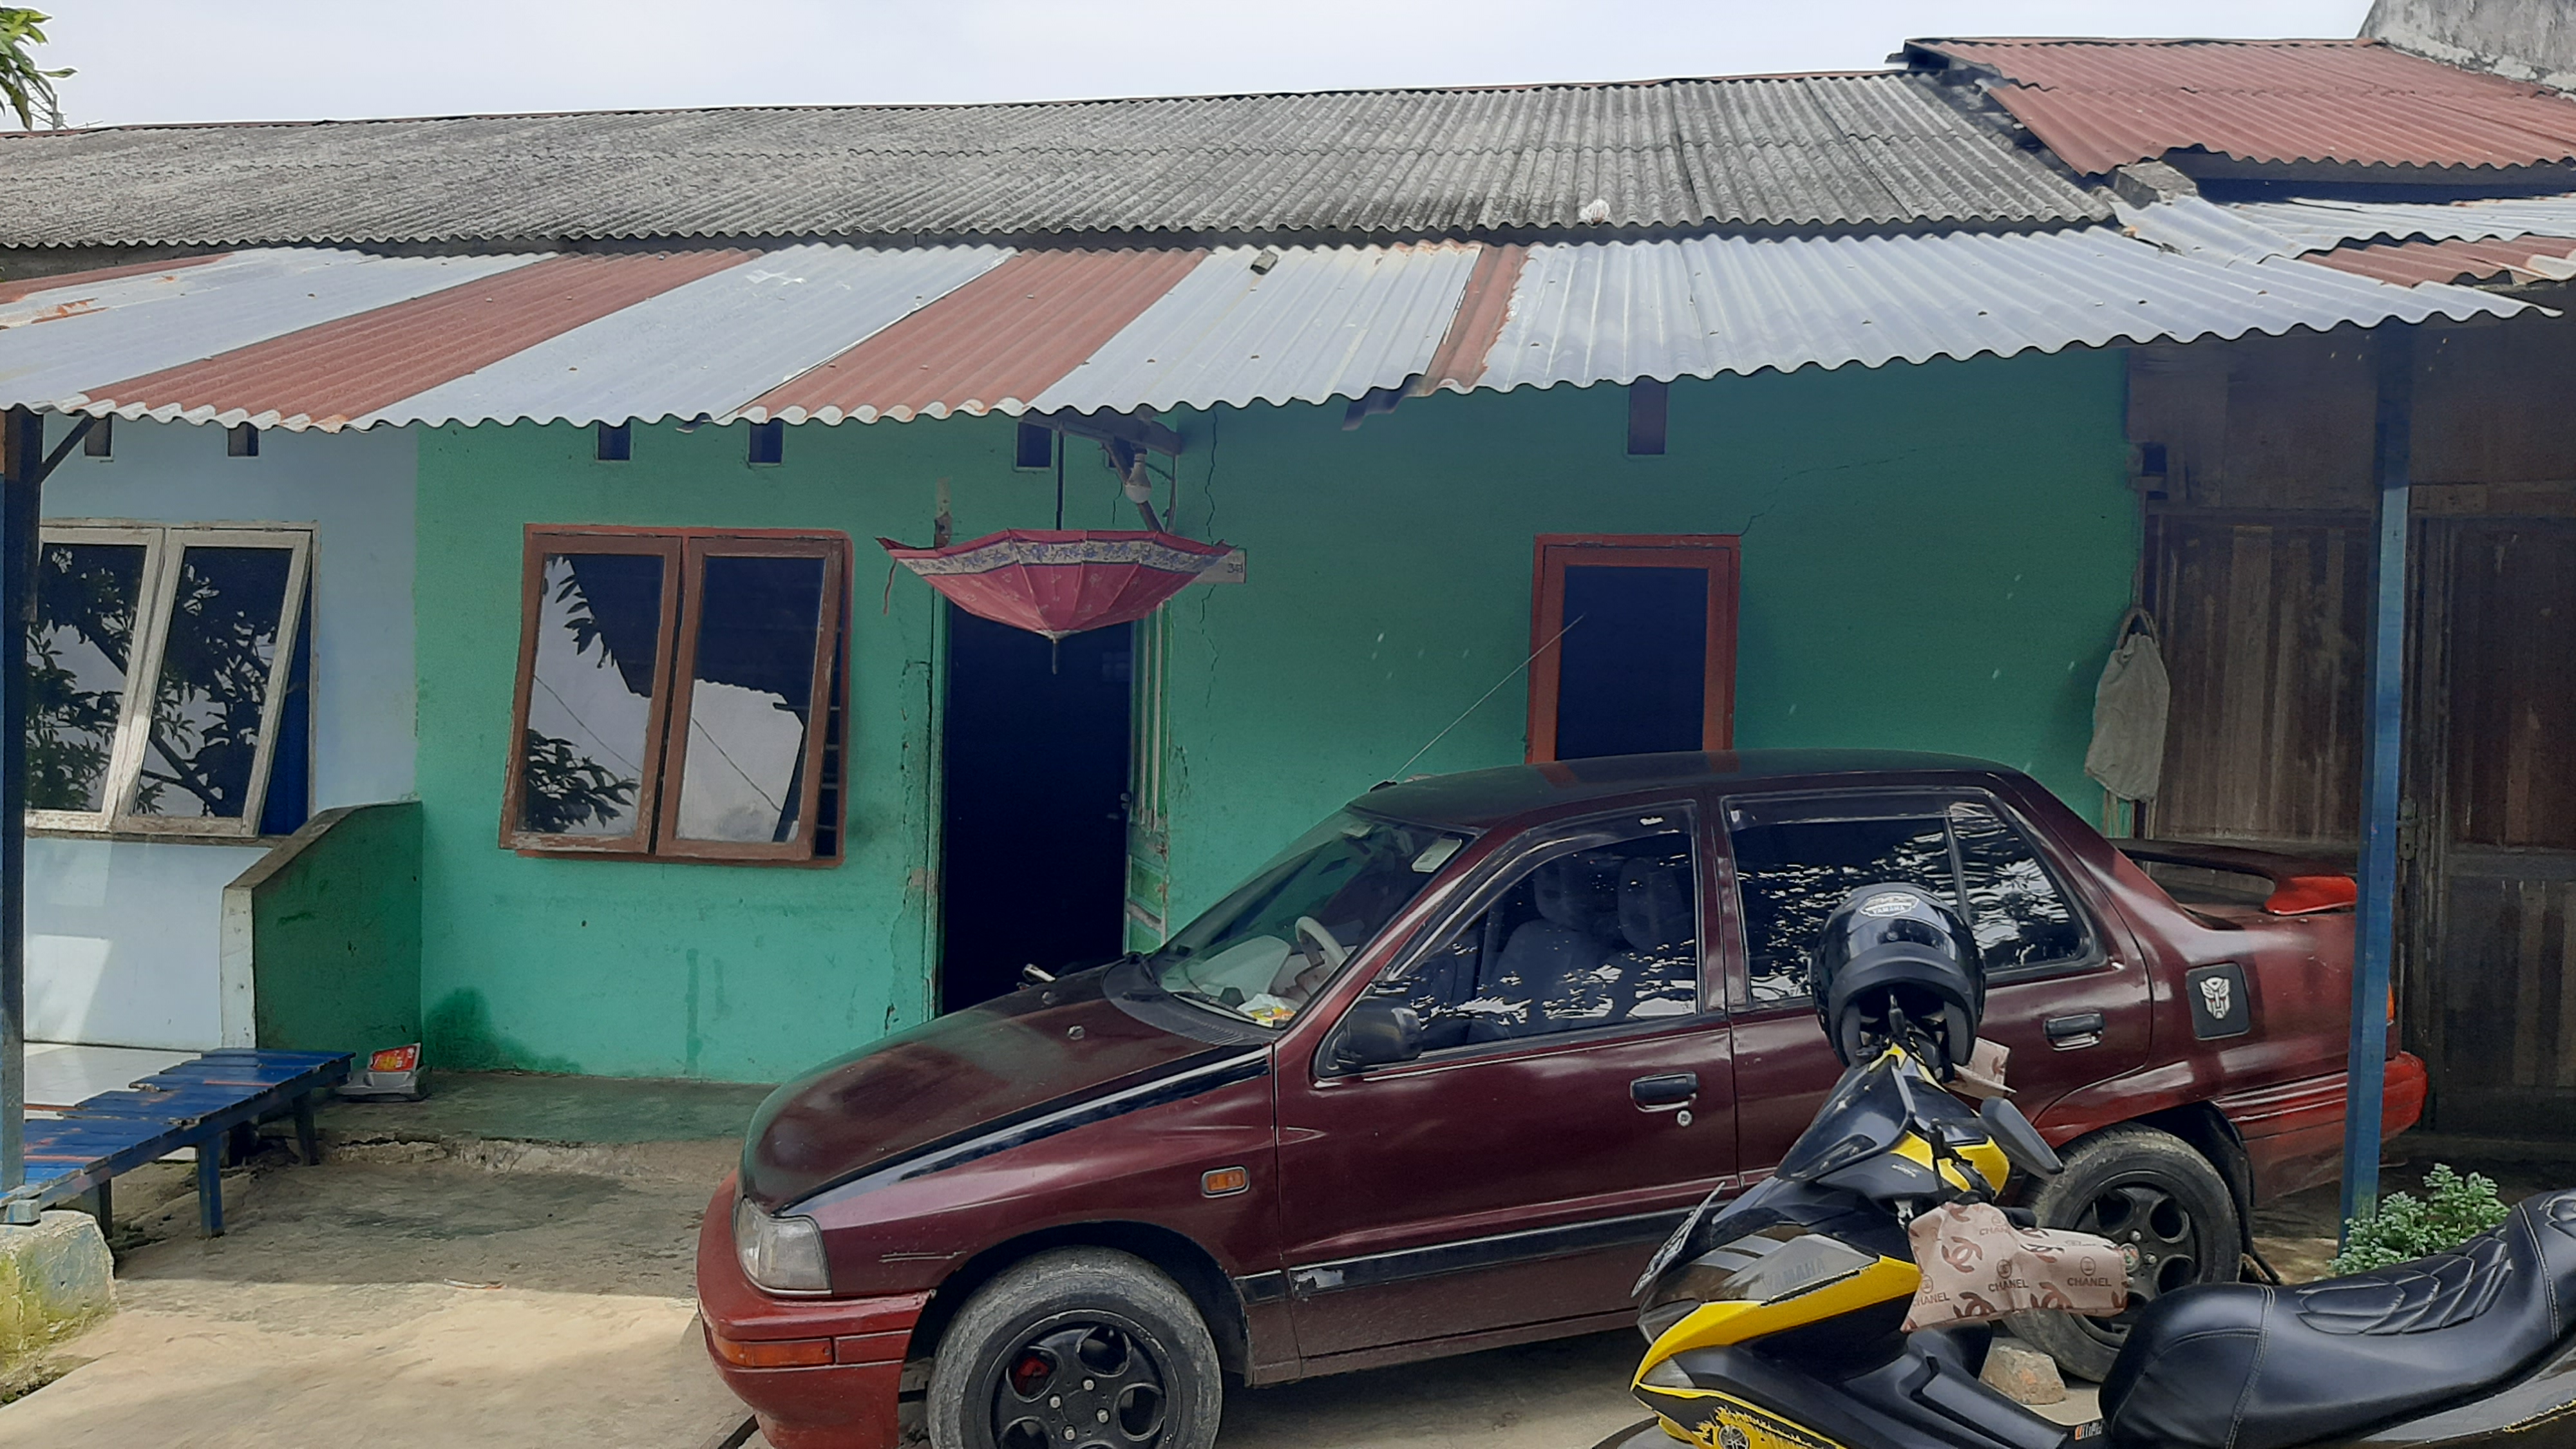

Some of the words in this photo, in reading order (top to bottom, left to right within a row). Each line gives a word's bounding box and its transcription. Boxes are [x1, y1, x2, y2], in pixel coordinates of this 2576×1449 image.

[1765, 1258, 1826, 1291] YAMAHA
[1988, 1279, 2029, 1292] CHANEL
[2067, 1277, 2112, 1287] CHANEL
